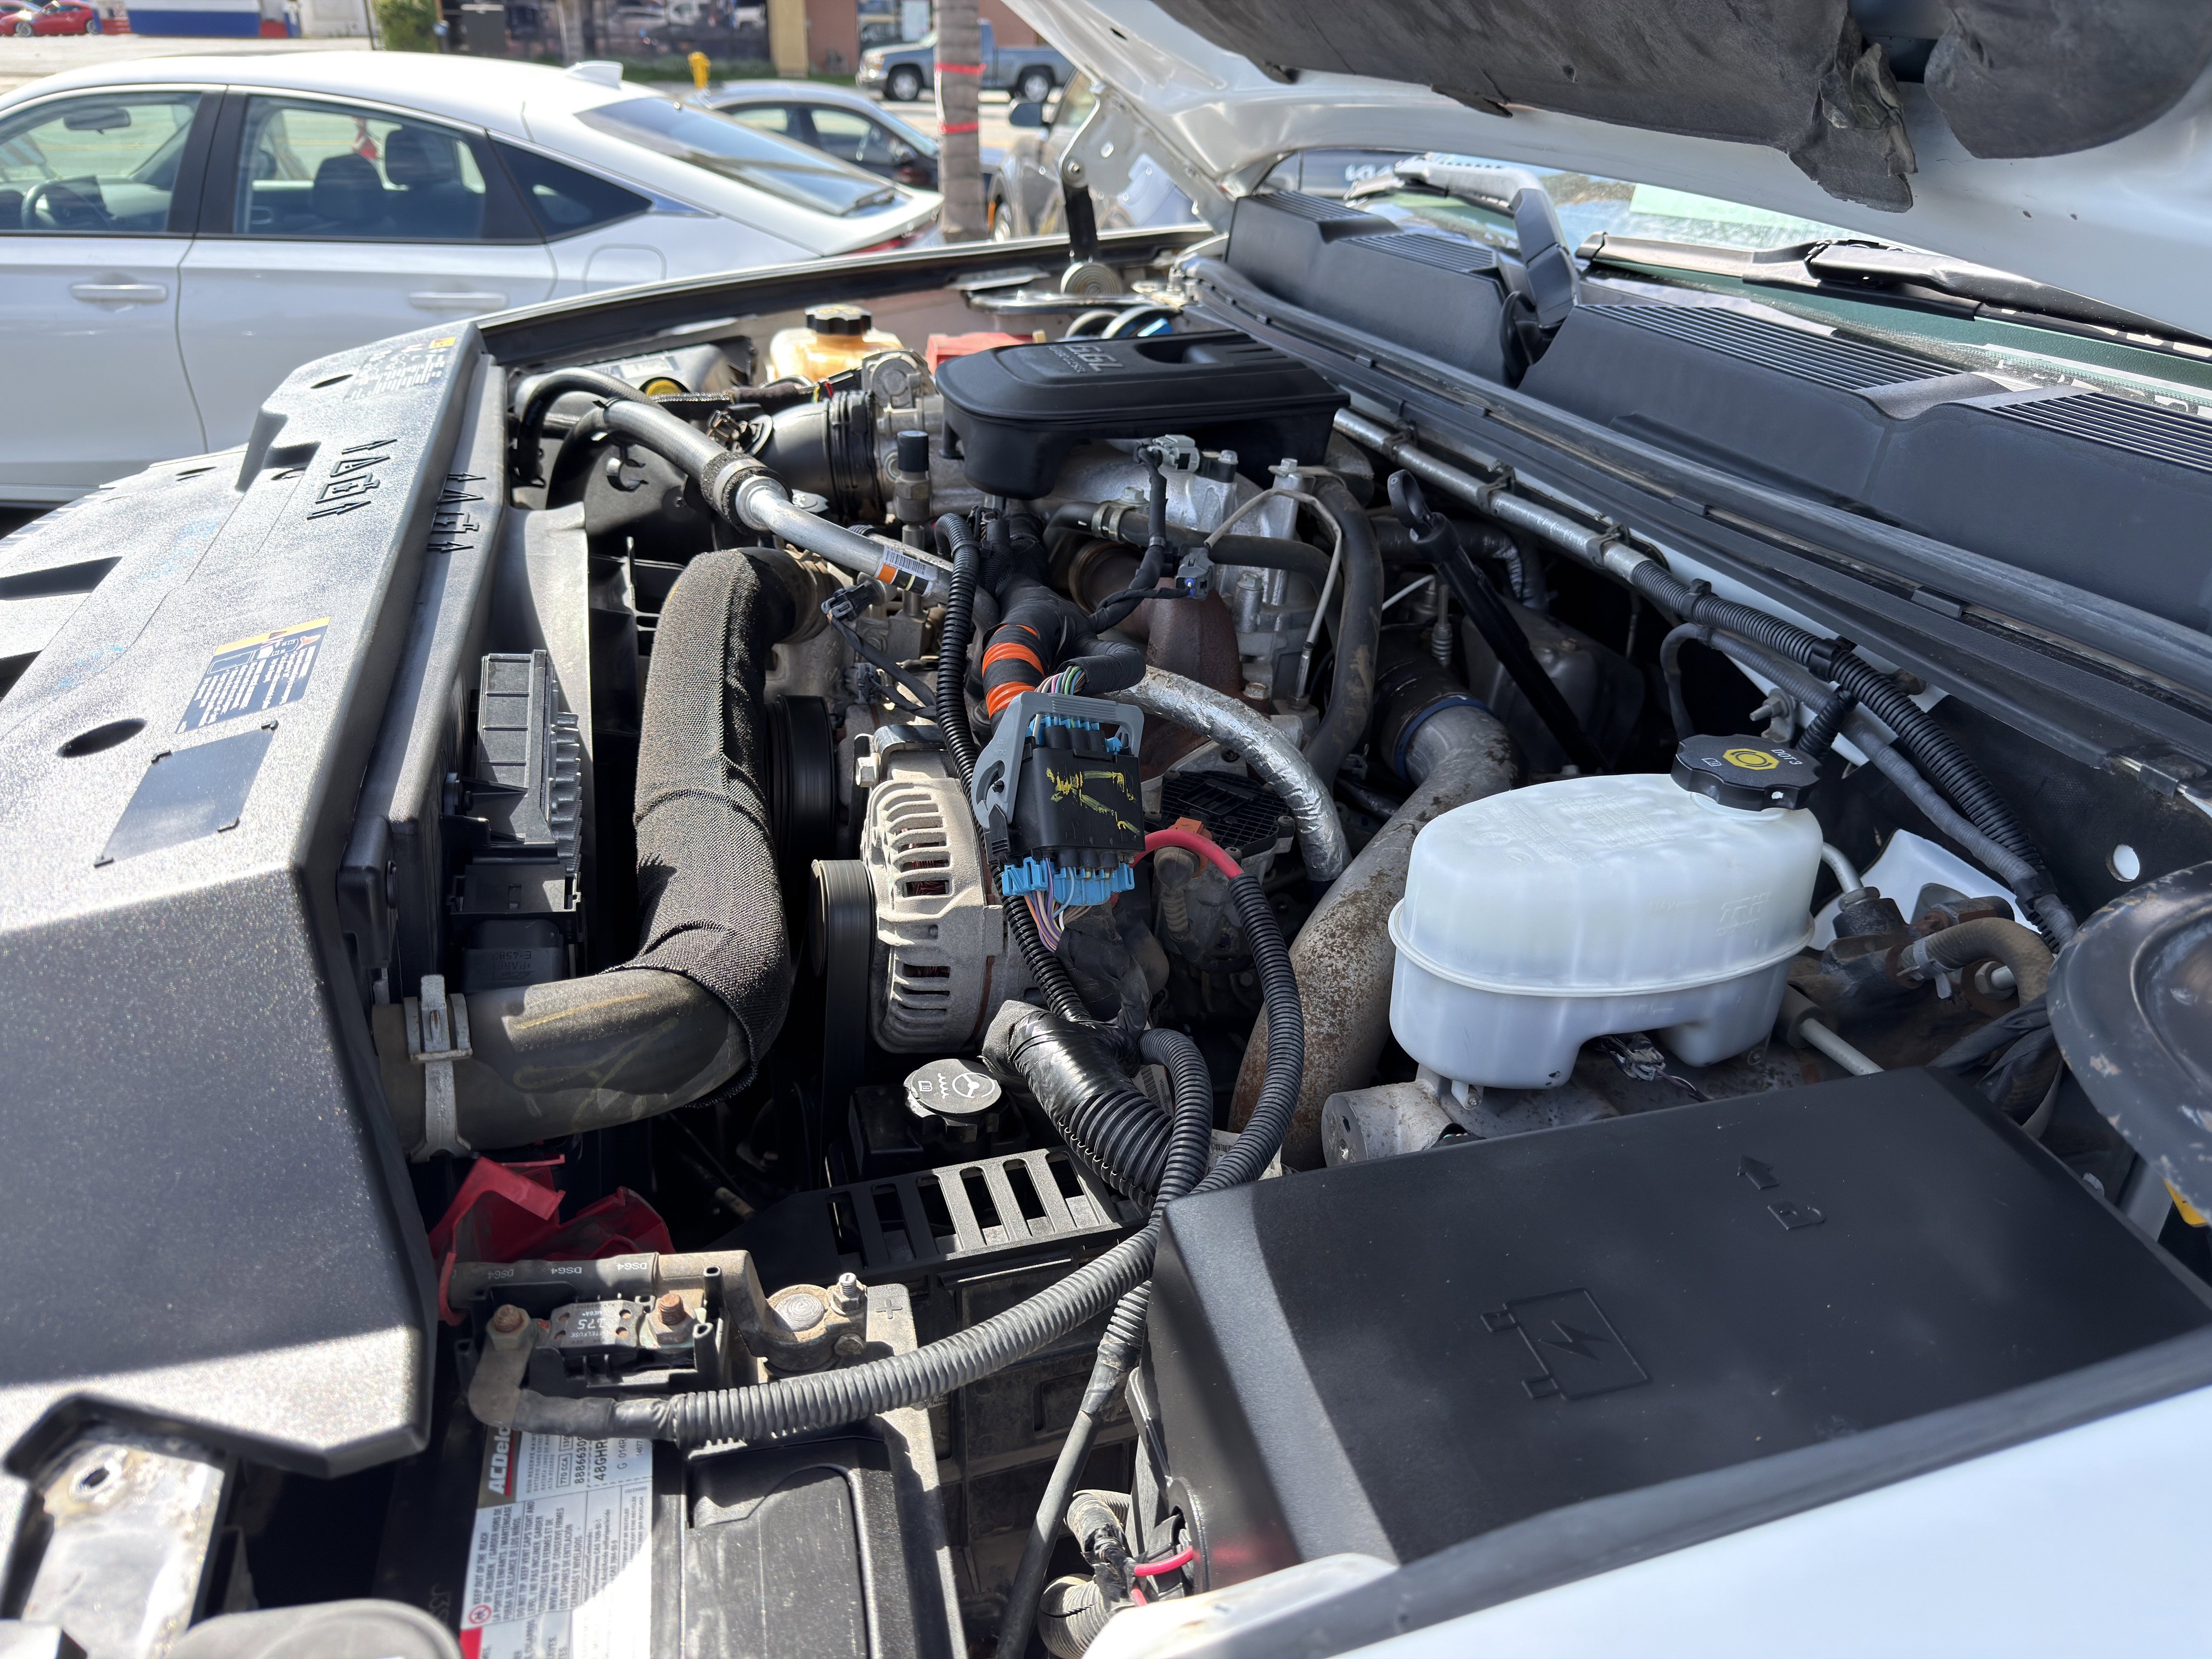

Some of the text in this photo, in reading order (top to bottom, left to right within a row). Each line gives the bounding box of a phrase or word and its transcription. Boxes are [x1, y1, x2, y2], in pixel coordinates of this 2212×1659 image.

[1770, 749, 1797, 760] DOT
[488, 1425, 511, 1495] ACDelc
[527, 1502, 535, 1513] AND
[492, 1516, 501, 1532] HORS
[524, 1515, 533, 1531] TIGHT
[555, 1508, 564, 1527] FIRMES
[534, 1516, 543, 1538] GARDER
[511, 1537, 519, 1548] LOS
[523, 1532, 532, 1548] CAPS
[553, 1530, 562, 1559] CONSERVE
[522, 1549, 531, 1564] VENT
[473, 1532, 489, 1604] KEEP OUT OF THE REACH
[506, 1559, 517, 1585] ALCANCE
[521, 1566, 529, 1579] KEEP
[561, 1568, 570, 1596] TAPONES
[505, 1587, 514, 1599] DEL
[538, 1575, 549, 1612] COUVERCLES
[570, 1575, 580, 1607] CERRADAS
[518, 1594, 526, 1606] NOT
[560, 1598, 568, 1609] LOS
[503, 1600, 512, 1620] FUERA
[517, 1608, 524, 1617] DO
